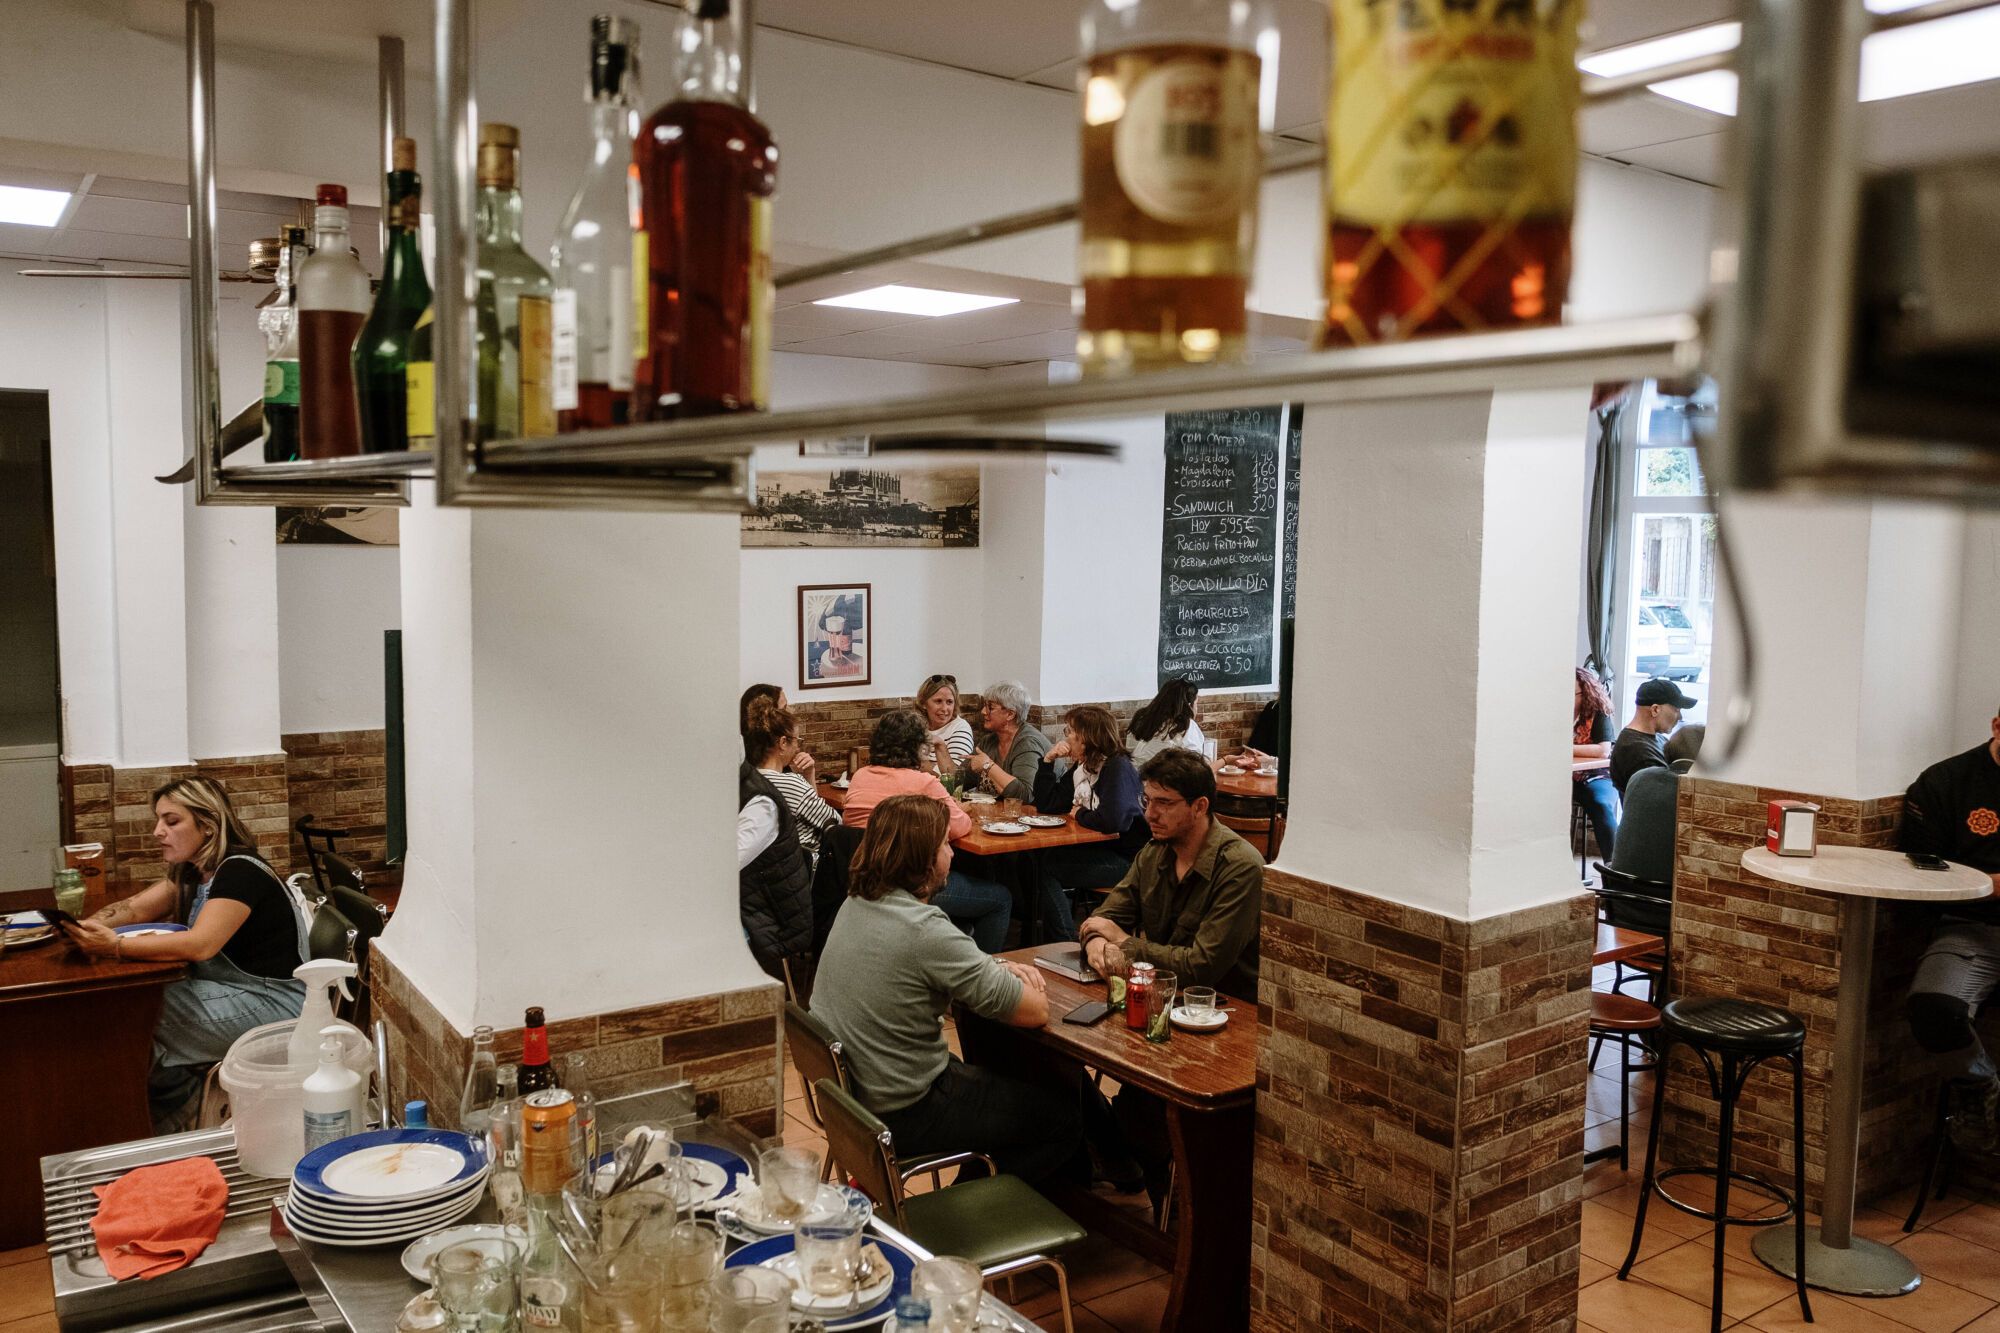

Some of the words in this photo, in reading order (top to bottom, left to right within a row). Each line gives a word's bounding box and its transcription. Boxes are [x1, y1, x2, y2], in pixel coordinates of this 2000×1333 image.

[1251, 477, 1277, 494] 1'50
[1249, 494, 1275, 513] 3'20
[1191, 518, 1211, 533] HOY
[1239, 552, 1273, 563] BOCADILLO
[1169, 574, 1243, 593] BOCADILLO
[1178, 605, 1250, 620] HAMBURGUESA
[1201, 622, 1240, 637] QUESO
[1224, 656, 1252, 675] 5'50
